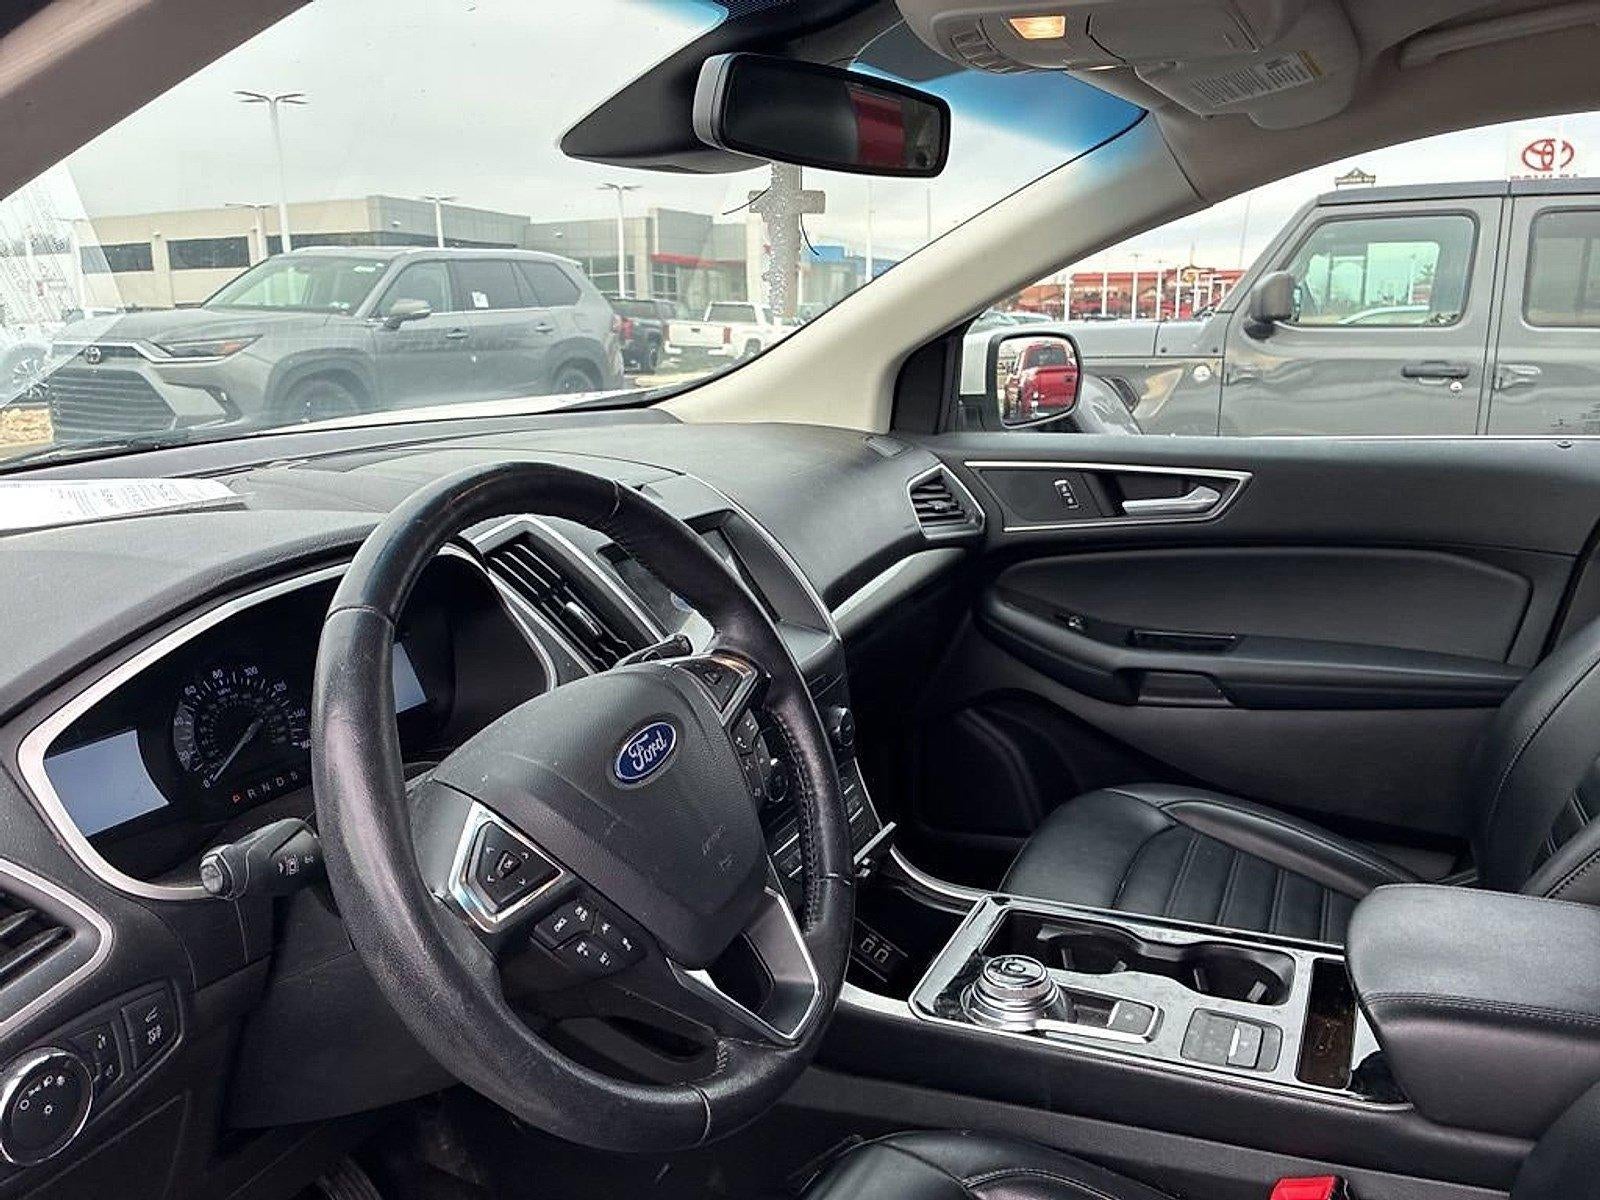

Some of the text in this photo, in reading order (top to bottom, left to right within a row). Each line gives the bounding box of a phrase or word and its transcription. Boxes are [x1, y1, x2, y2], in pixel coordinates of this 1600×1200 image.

[212, 668, 224, 679] 80
[628, 729, 668, 772] Ford
[246, 788, 256, 799] R
